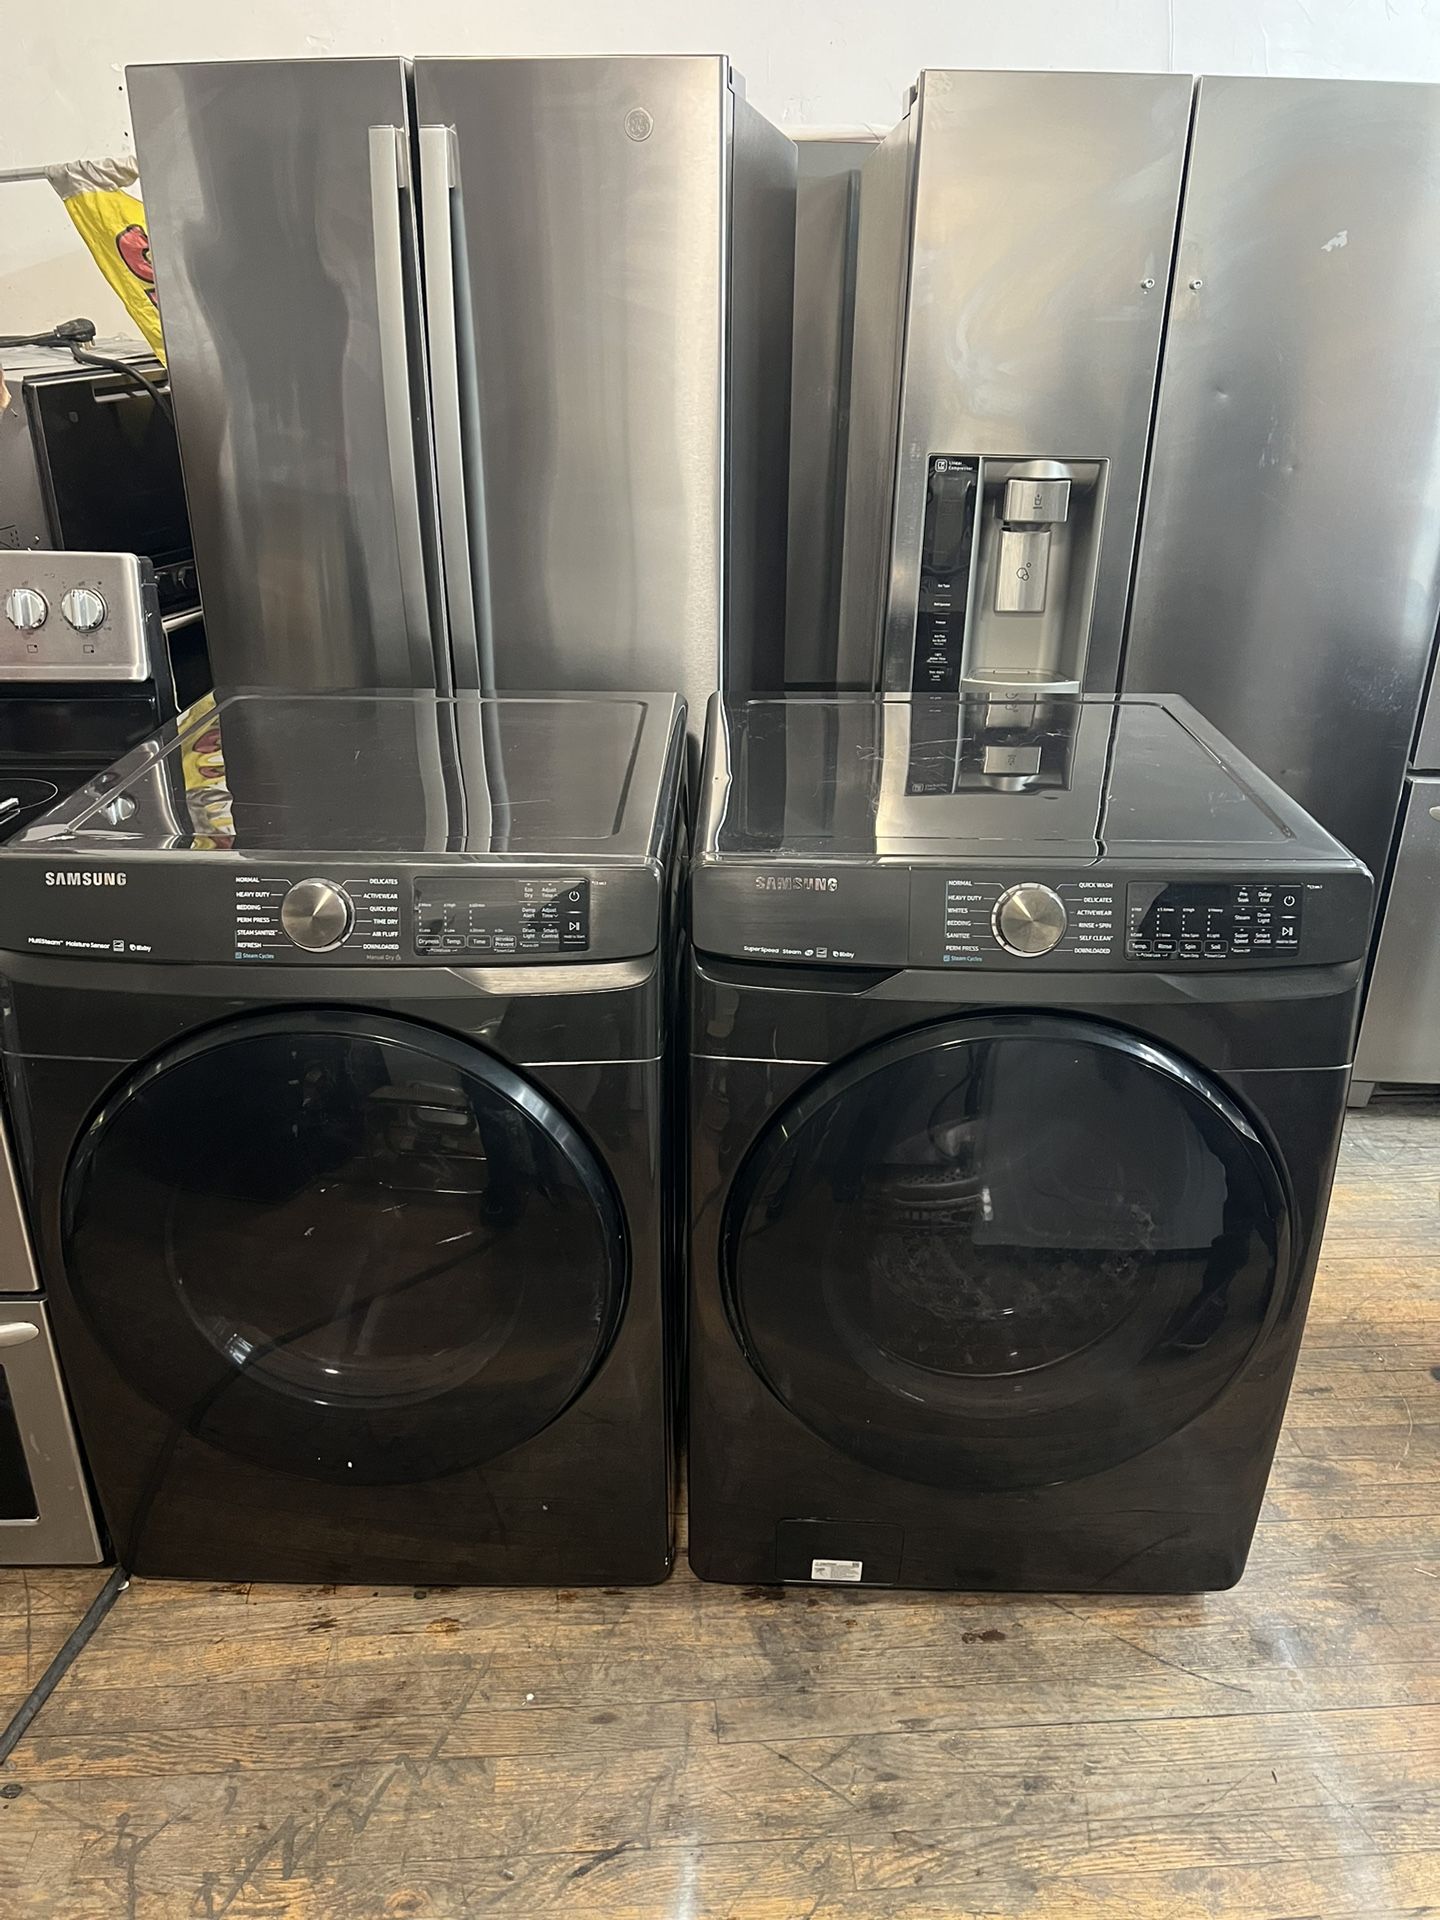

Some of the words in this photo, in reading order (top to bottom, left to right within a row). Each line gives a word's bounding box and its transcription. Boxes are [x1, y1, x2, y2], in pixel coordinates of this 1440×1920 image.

[45, 872, 127, 886] SAMSUNG
[755, 876, 838, 892] SAMSUNG
[65, 940, 90, 949] Moisture
[90, 942, 111, 950] Sensor
[136, 944, 152, 953] Bixby
